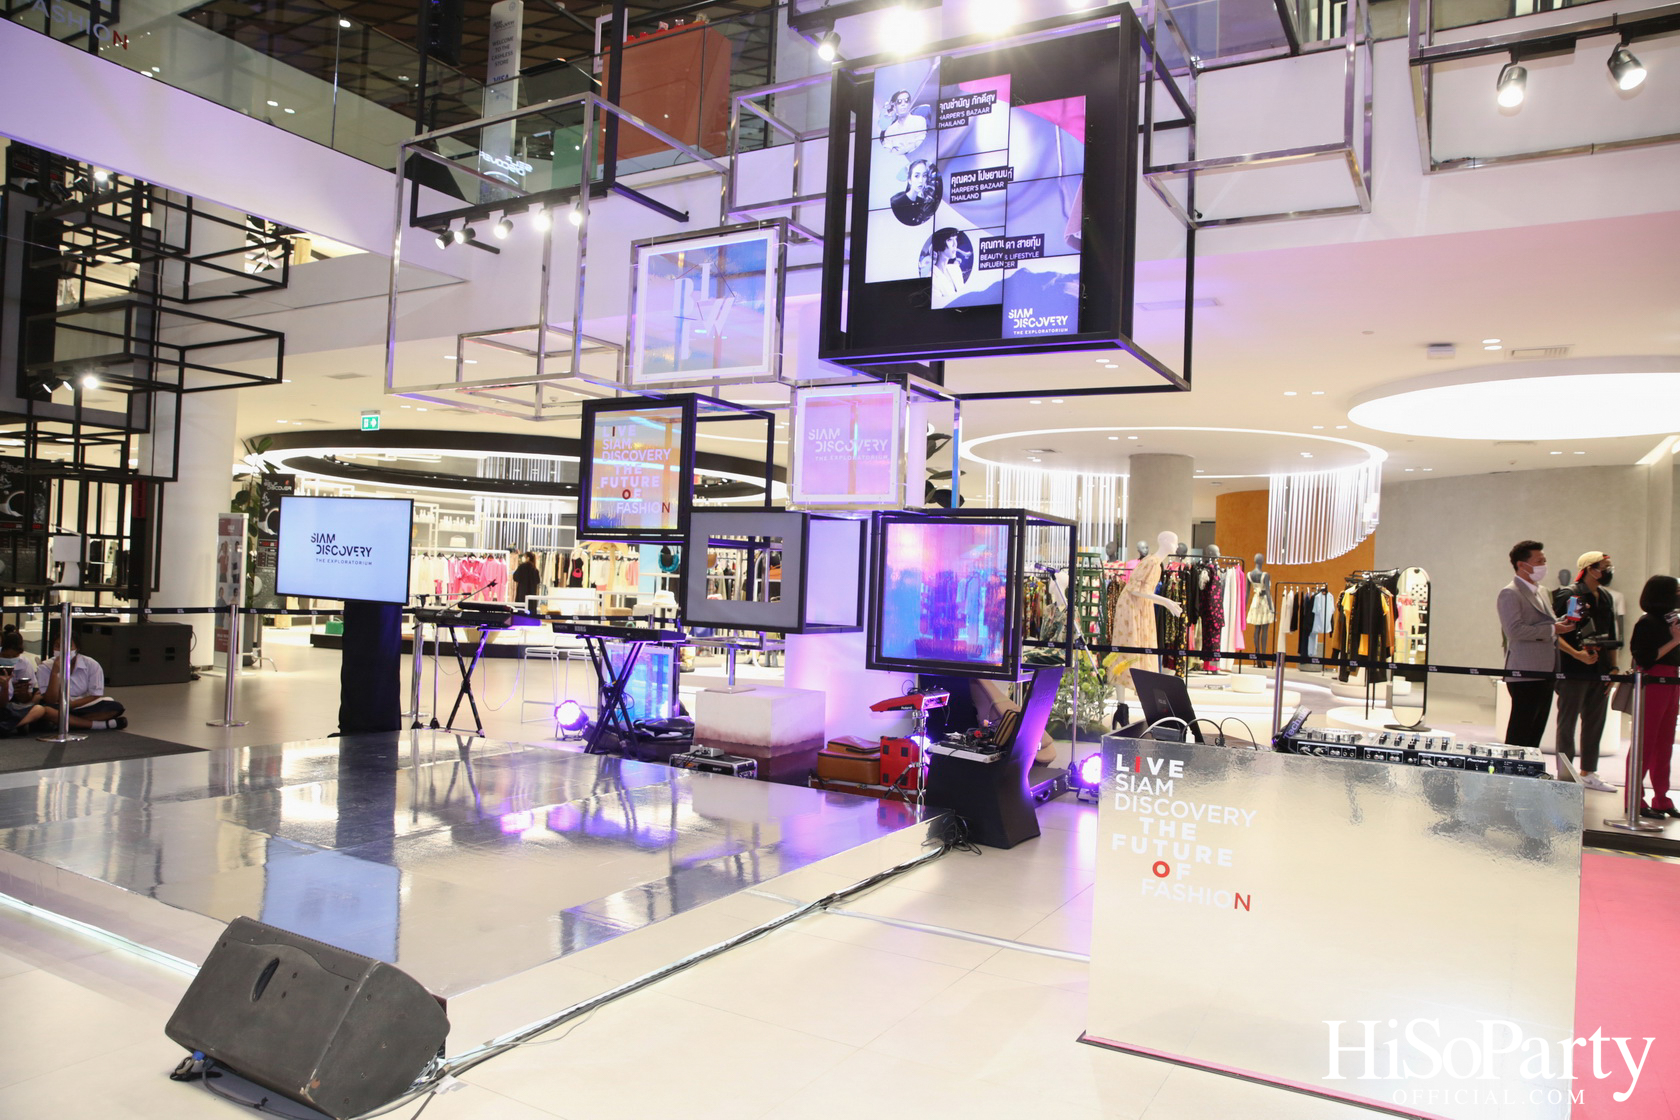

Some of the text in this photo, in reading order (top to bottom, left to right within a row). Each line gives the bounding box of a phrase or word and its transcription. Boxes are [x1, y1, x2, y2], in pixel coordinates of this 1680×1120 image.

[16, 0, 129, 50] ASHION
[492, 36, 514, 46] WELCOME
[491, 51, 514, 61] CASHLESS
[495, 59, 509, 67] STORE
[966, 107, 990, 117] BAZAAR
[938, 119, 966, 129] THAILAND
[951, 181, 1004, 194] HARPER'S BAZAAR
[951, 192, 980, 202] THAILAND
[980, 252, 1003, 261] BEAUTY
[1009, 251, 1040, 260] LIFESTYLE
[980, 260, 1015, 269] INFLUENCER
[1008, 308, 1033, 319] SIAM
[1013, 315, 1069, 329] DISCOVERY
[602, 424, 637, 437] LIVE
[808, 428, 841, 441] SIAM
[602, 439, 632, 450] SIAM
[815, 439, 889, 453] DISCOVERY
[601, 448, 671, 461] DISCOVERY
[614, 463, 643, 475] THE
[600, 475, 661, 489] FUTURE
[622, 488, 642, 500] OF
[616, 502, 671, 514] FASHION
[310, 532, 336, 544] SIAM
[315, 544, 373, 558] DISCOVERY
[1116, 754, 1184, 779] LIVE
[1115, 774, 1174, 797] SIAM
[1114, 793, 1258, 828] DISCOVERY
[1139, 816, 1197, 841] THE
[1111, 833, 1233, 867] FUTURE
[1152, 860, 1192, 881] OF
[1140, 878, 1251, 912] FASHION
